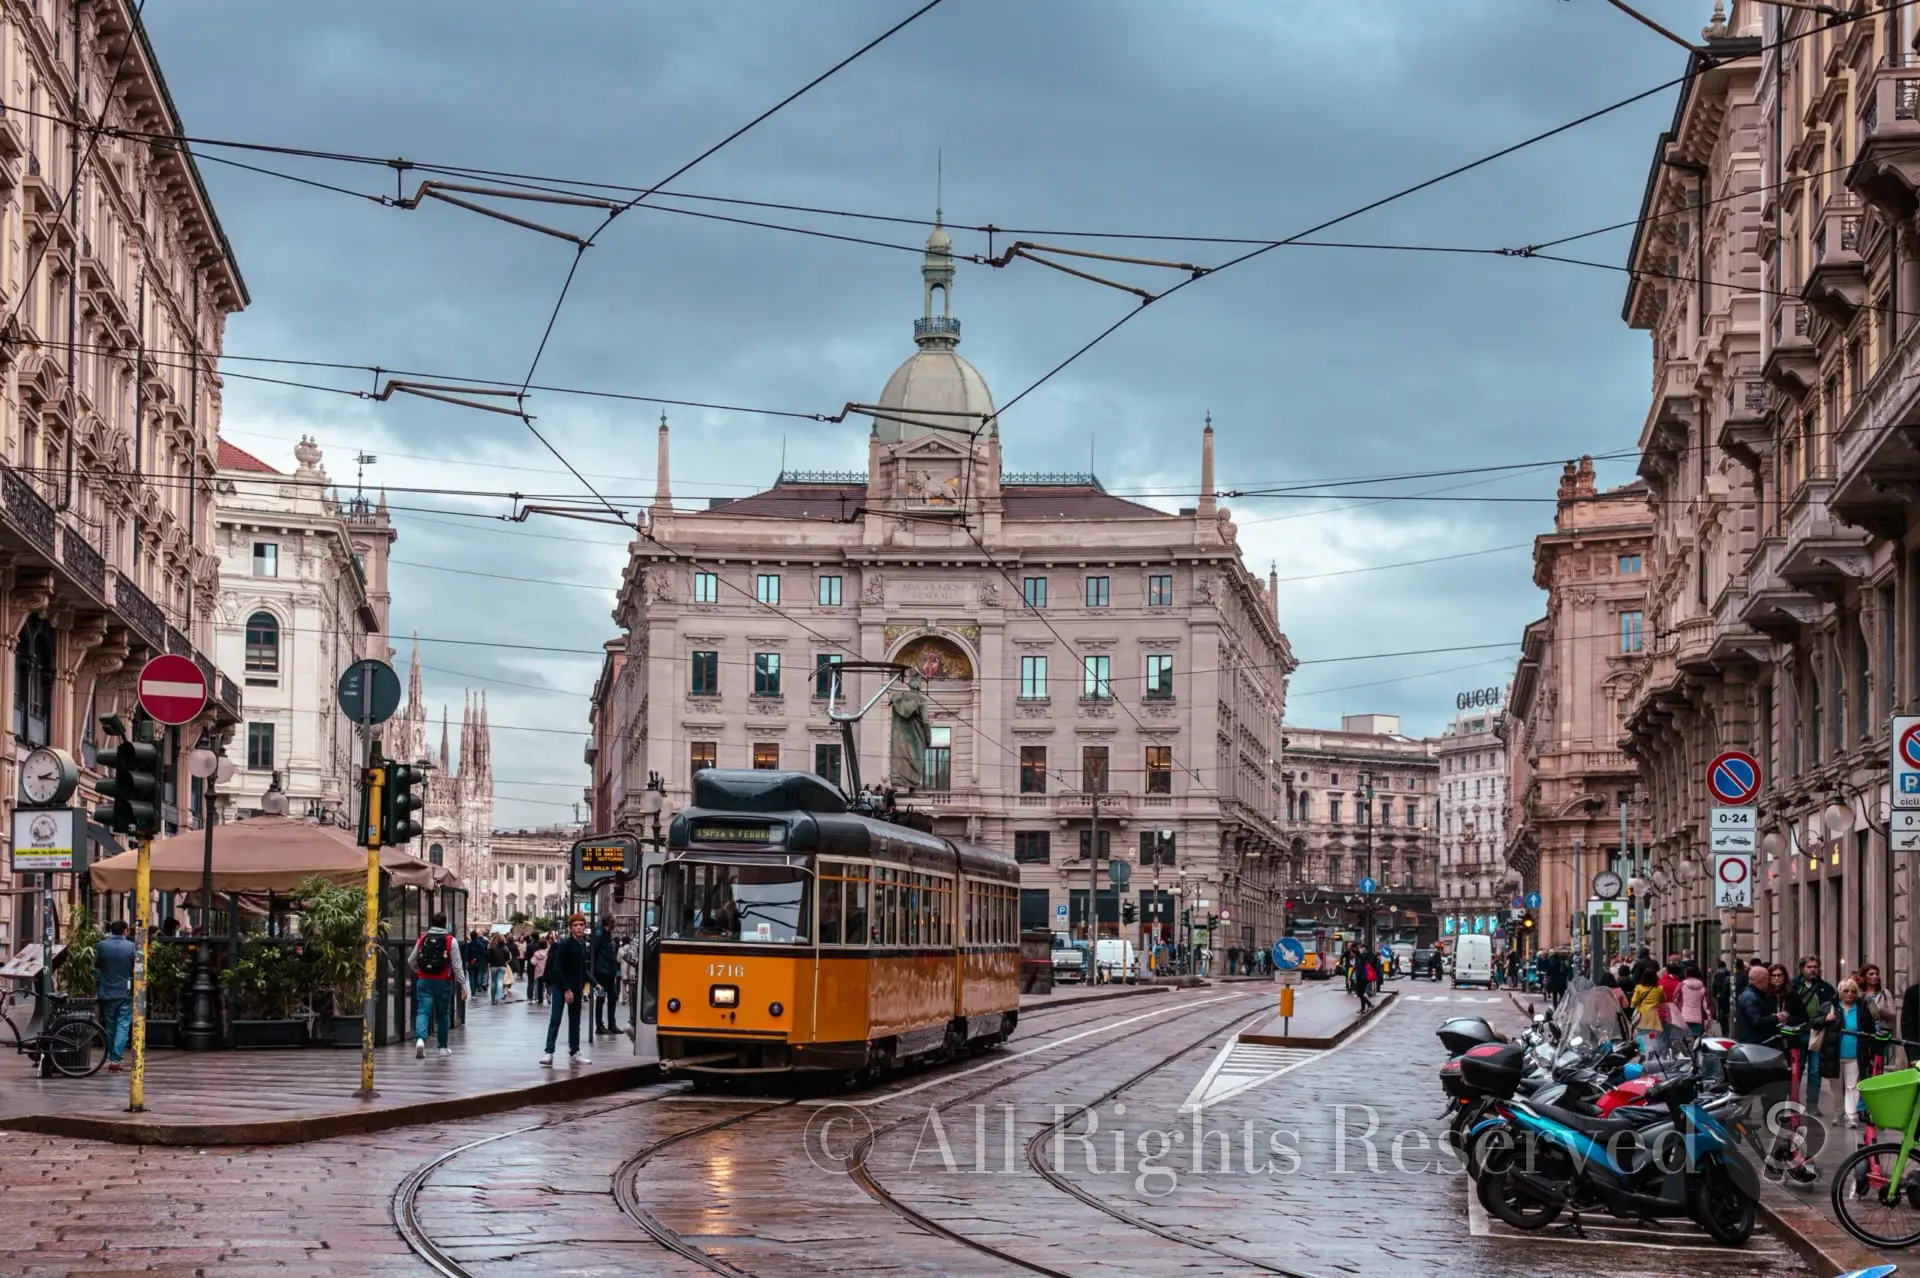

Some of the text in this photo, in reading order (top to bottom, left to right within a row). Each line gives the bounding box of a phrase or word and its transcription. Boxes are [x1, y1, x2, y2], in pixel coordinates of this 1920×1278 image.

[1457, 686, 1499, 710] GUCCI
[1719, 813, 1748, 823] 0-24
[706, 963, 744, 977] 4716
